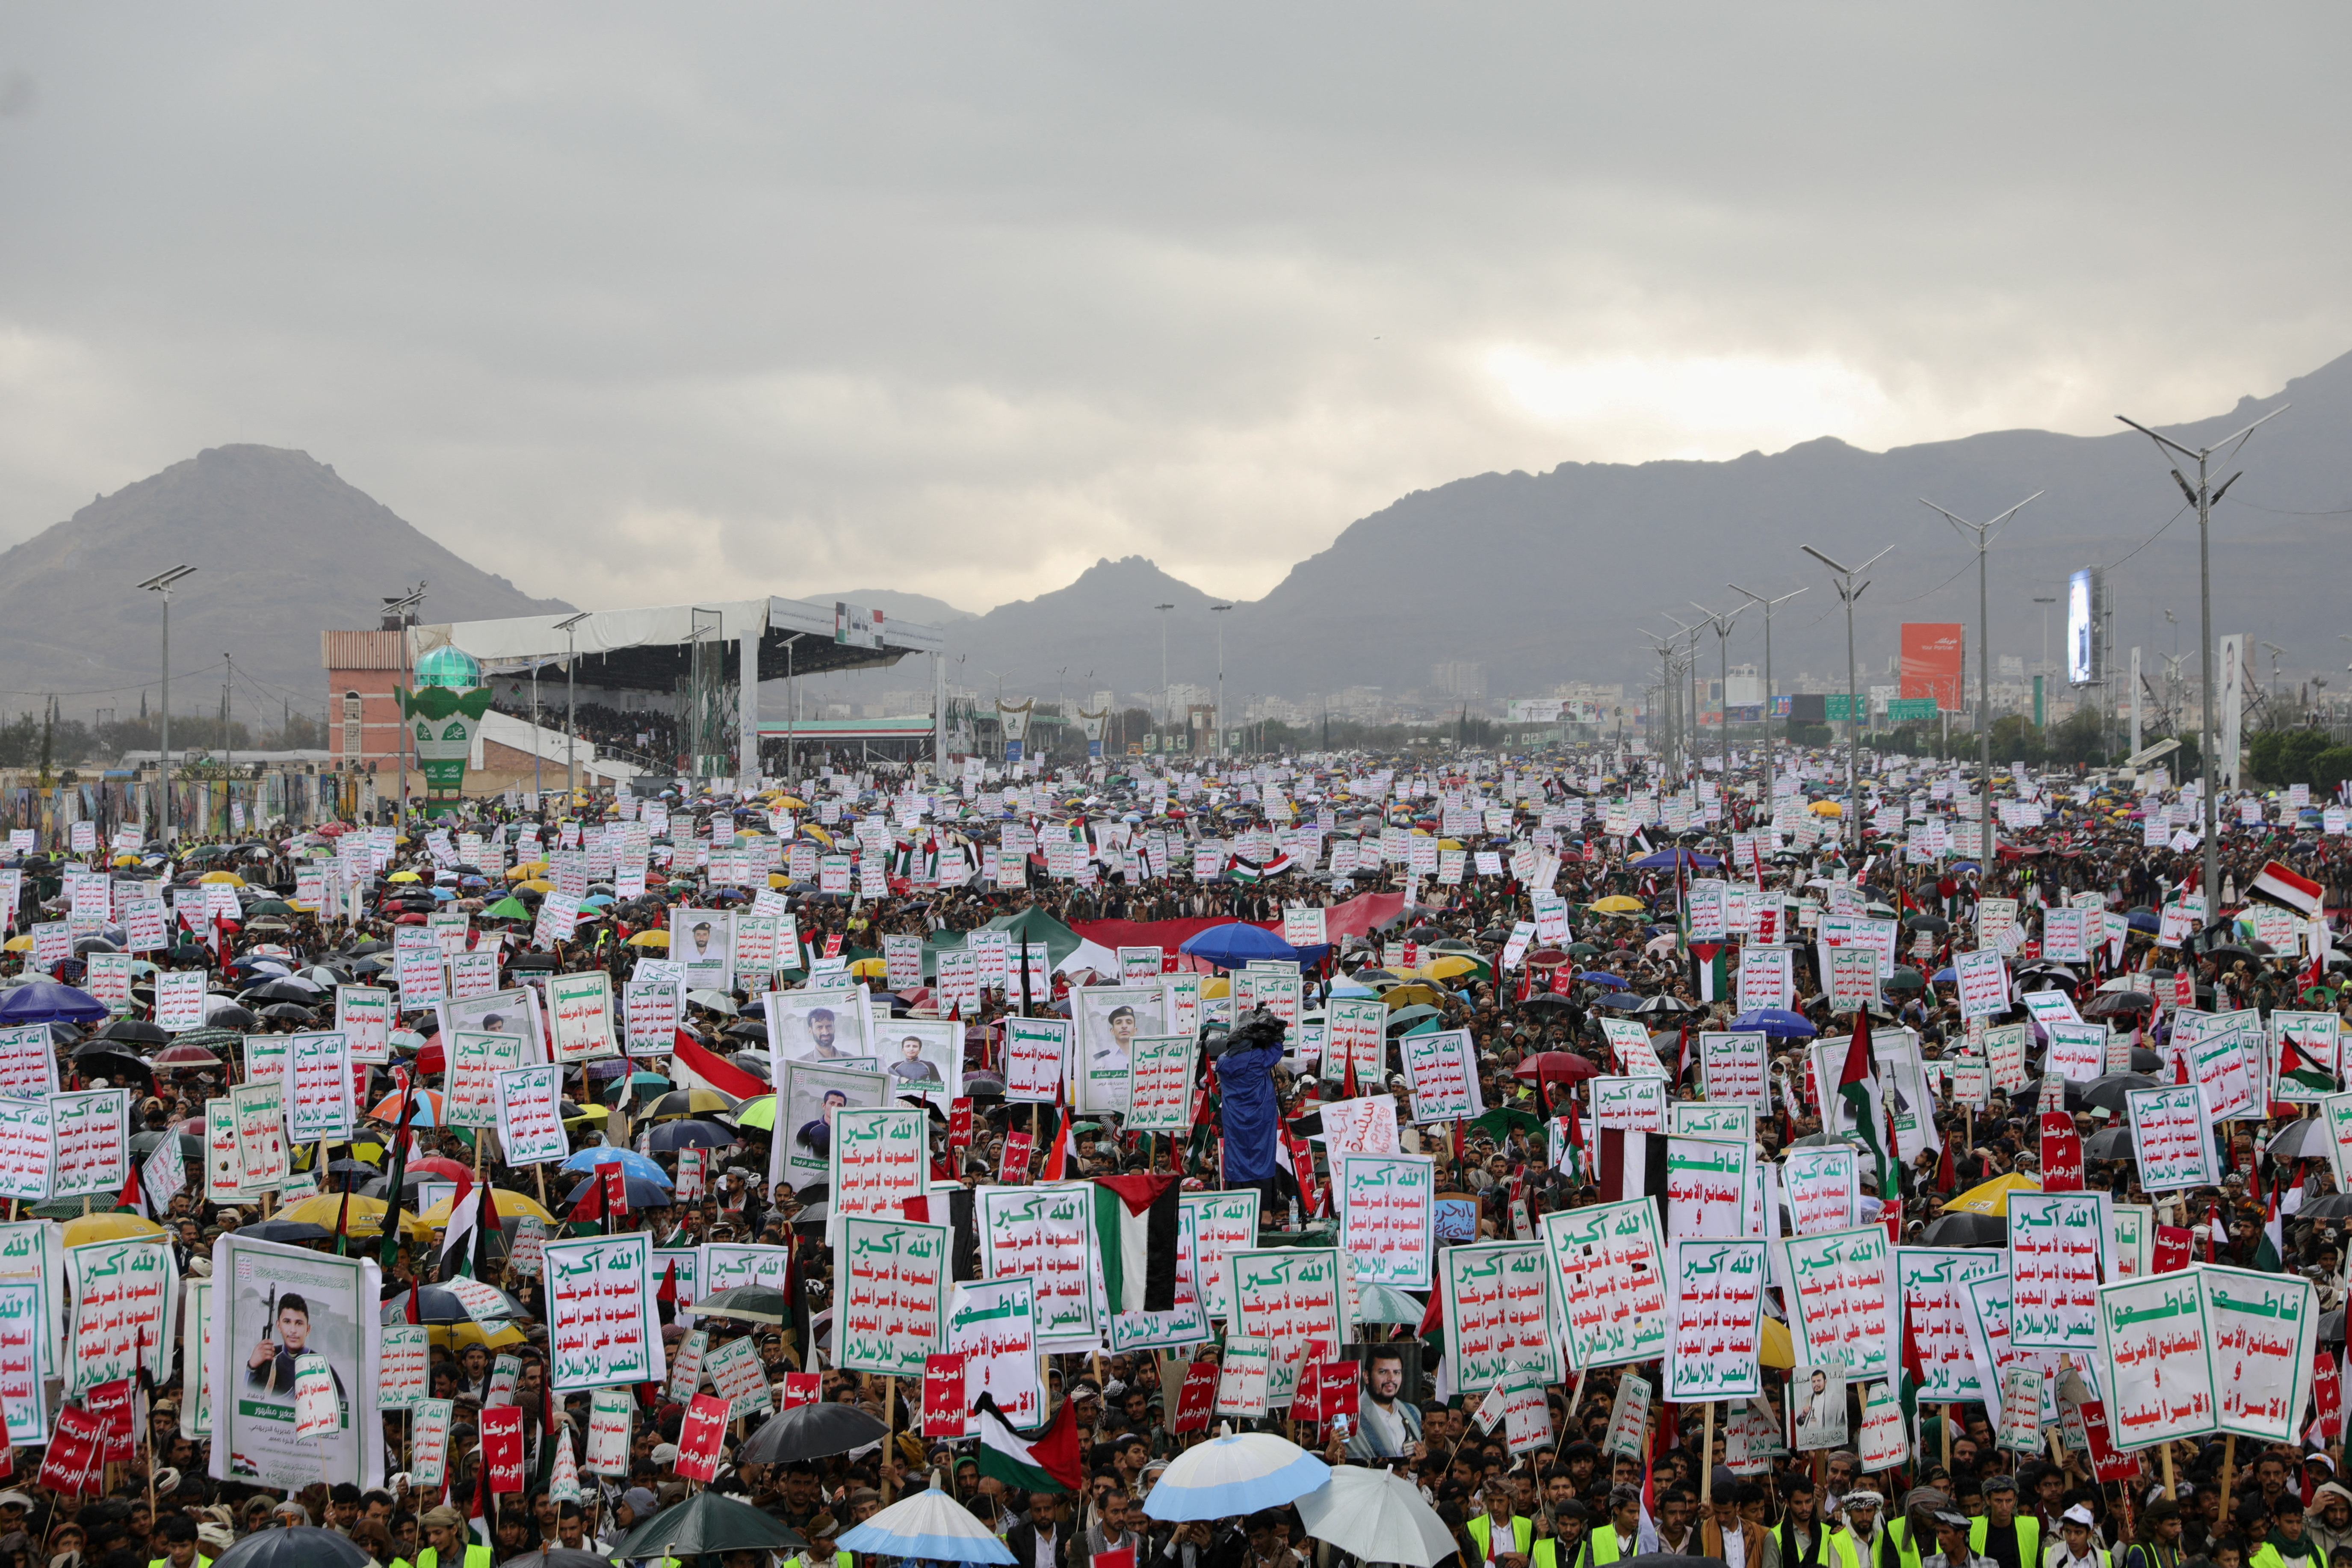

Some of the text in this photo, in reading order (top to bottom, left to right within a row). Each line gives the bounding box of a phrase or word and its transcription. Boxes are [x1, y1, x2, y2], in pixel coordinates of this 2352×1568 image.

[556, 981, 603, 1004] قاطعوا
[558, 1003, 604, 1020] البضائع الأمريكية
[582, 1022, 586, 1033] و
[1012, 1025, 1062, 1042] قاطعوا
[562, 1034, 609, 1053] الإسرائيلية
[1011, 1045, 1060, 1061] البضائع الأمريكية
[1136, 1041, 1188, 1064] الله أكبر
[1031, 1063, 1036, 1075] و
[1135, 1061, 1186, 1077] الموت لأمريكا
[1134, 1078, 1185, 1093] الموت لإسرائيل
[56, 1097, 119, 1123] الله أكبر
[1132, 1093, 1184, 1109] اللعنة على اليهود
[2138, 1091, 2195, 1116] الله أكبر
[956, 1118, 962, 1126] أم
[1131, 1108, 1182, 1127] النصر للإسلام
[2139, 1113, 2197, 1129] الموت لأمريكا
[57, 1119, 119, 1137] الموت لأمريكا
[949, 1129, 970, 1139] الإرهاب
[58, 1137, 118, 1157] الموت لإسرائيل
[2142, 1131, 2199, 1148] الموت لإسرائيل
[2057, 1145, 2066, 1158] أم
[2144, 1146, 2201, 1164] اللعنة على اليهود
[57, 1153, 120, 1173] اللعنة على اليهود
[2043, 1165, 2081, 1179] الإرهاب
[2146, 1161, 2204, 1182] النصر للإسلام
[57, 1169, 120, 1192] النصر للإسلام
[555, 1246, 640, 1282] الله أكبر
[1682, 1246, 1761, 1282] الله أكبر
[555, 1279, 640, 1302] الموت لأمريكا
[1681, 1280, 1758, 1304] الموت لأمريكا
[556, 1303, 640, 1329] الموت لإسرائيل
[2107, 1287, 2198, 1333] قاطعوا
[1678, 1310, 1754, 1331] الموت لإسرائيل
[556, 1327, 642, 1353] اللعنة على اليهود
[1677, 1336, 1755, 1358] اللعنة على اليهود
[2114, 1329, 2202, 1368] البضائع الأمريكية
[558, 1349, 644, 1381] النصر للإسلام
[1245, 1365, 1266, 1377] البضائع
[1676, 1358, 1753, 1390] النصر للإسلام
[2154, 1366, 2160, 1389] و
[254, 1406, 277, 1416] مشهور
[688, 1405, 725, 1426] أمريكا
[2120, 1391, 2210, 1430] الإسرائيلية
[483, 1417, 521, 1437] أمريكا
[697, 1431, 706, 1443] أم
[498, 1442, 508, 1458] أم
[679, 1449, 716, 1468] الإرهاب
[489, 1463, 521, 1479] الإرها
